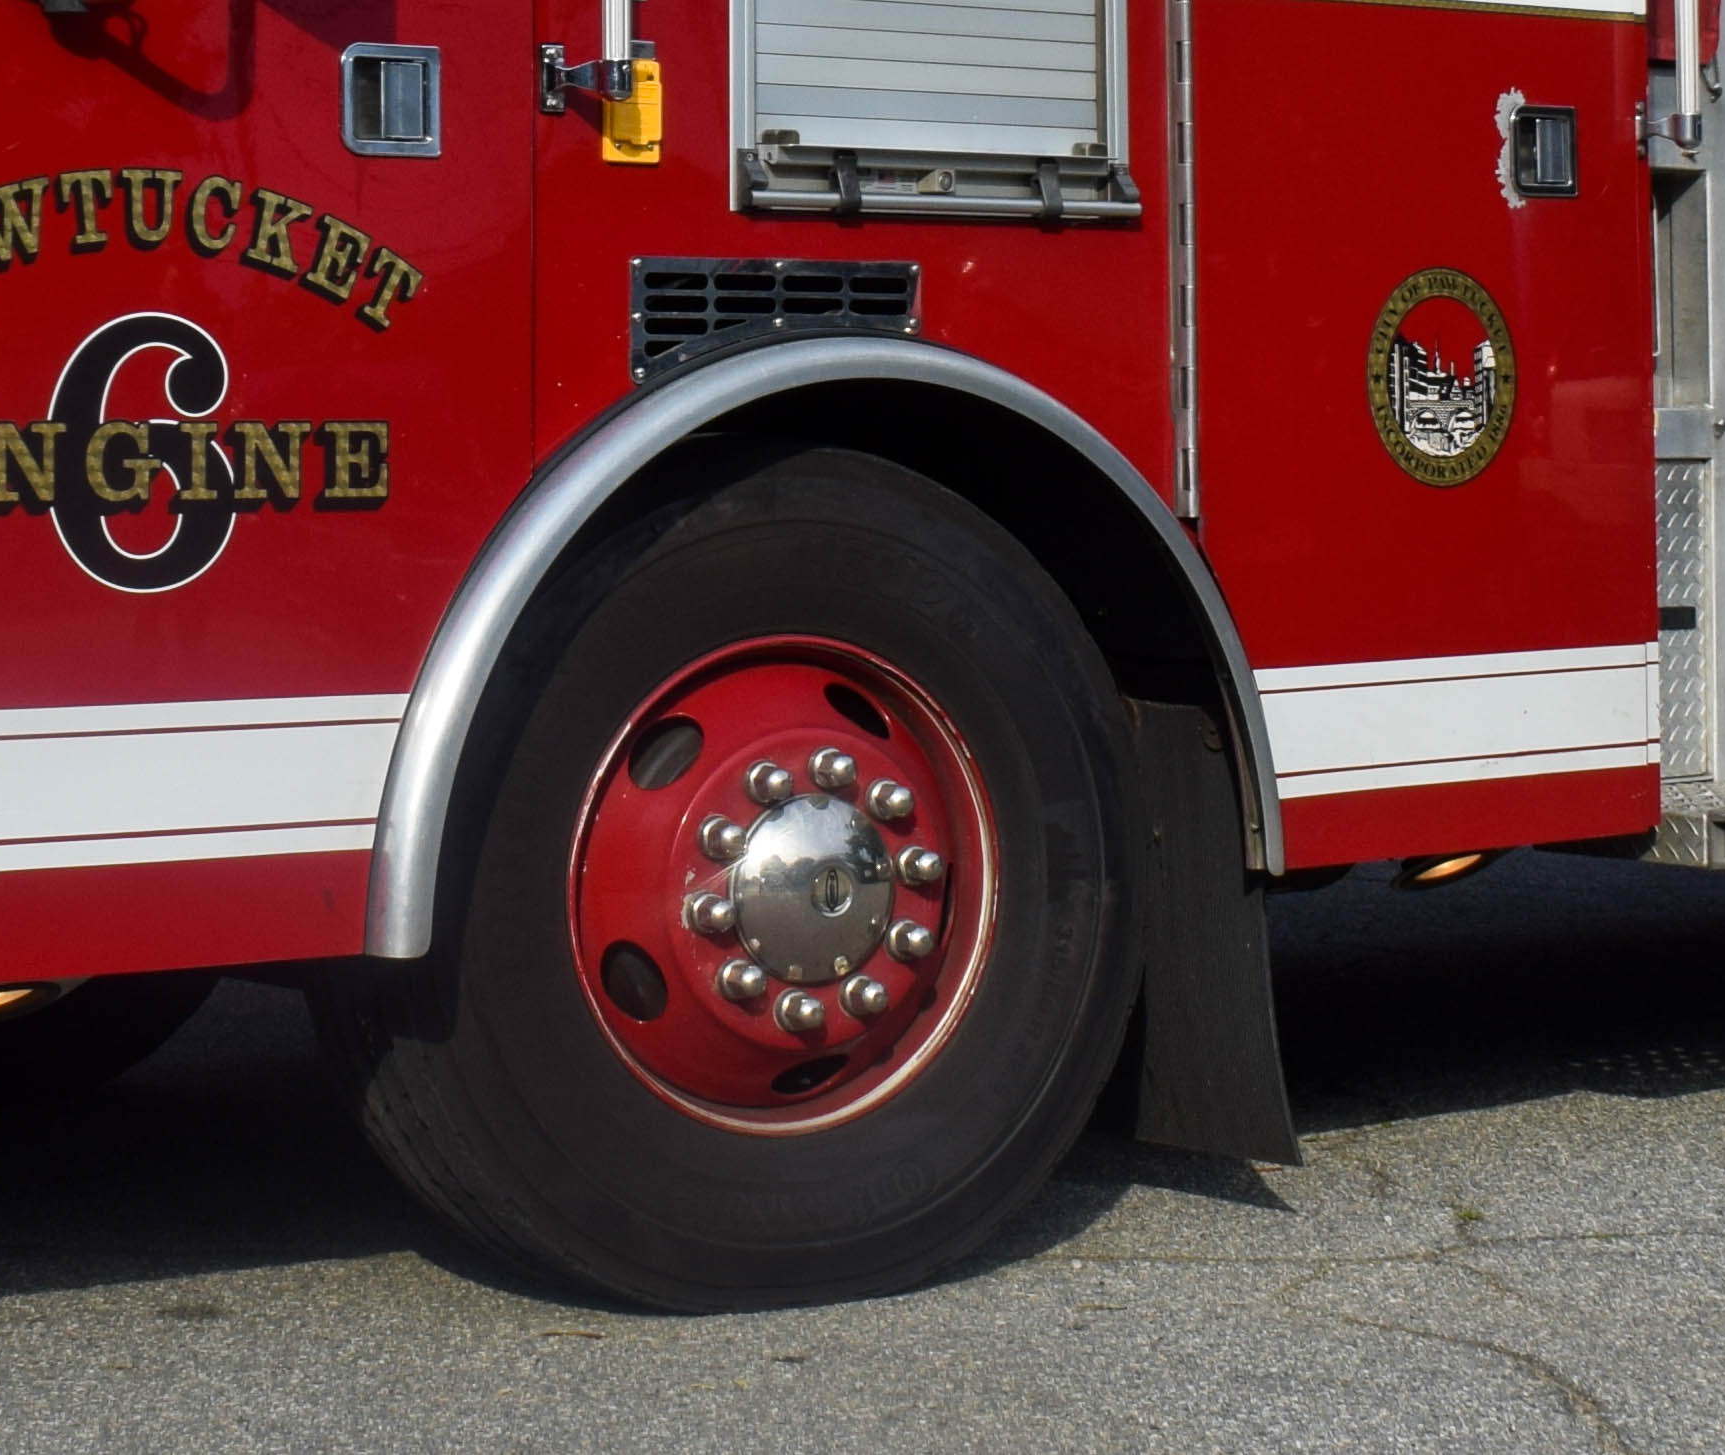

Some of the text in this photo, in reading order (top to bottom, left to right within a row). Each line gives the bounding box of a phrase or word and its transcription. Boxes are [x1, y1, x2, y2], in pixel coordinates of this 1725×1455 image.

[1400, 282, 1422, 305] OF
[46, 311, 237, 594] 6
[1376, 405, 1488, 479] INCORPORATED
